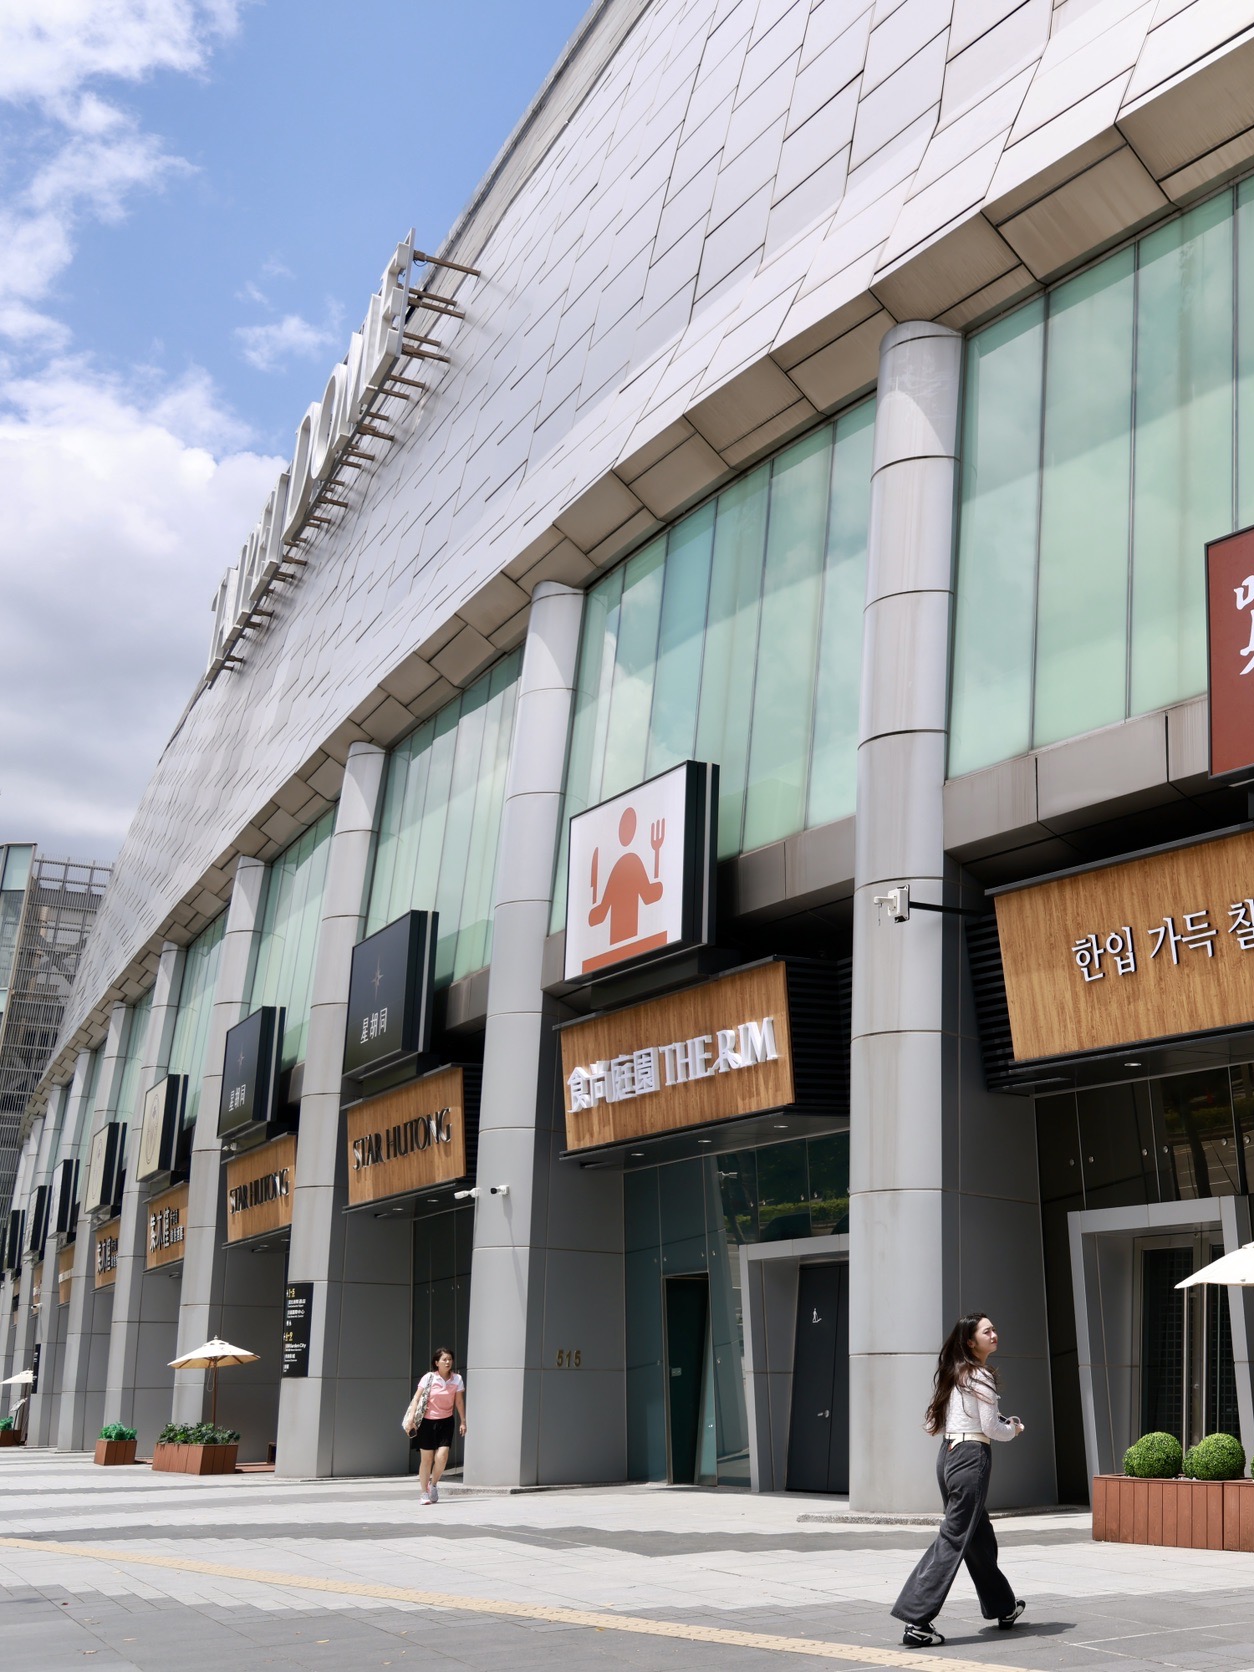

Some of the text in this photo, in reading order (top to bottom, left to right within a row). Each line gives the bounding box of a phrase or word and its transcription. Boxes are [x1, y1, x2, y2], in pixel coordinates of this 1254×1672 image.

[281, 228, 415, 541] DOME
[1072, 926, 1137, 982] 한입
[1147, 909, 1219, 965] 가득
[360, 1007, 388, 1044] 星胡同
[567, 1017, 779, 1113] 食尚庭園 THE RIM
[352, 1107, 452, 1171] STAR HUTONG
[229, 1168, 290, 1214] STAR HUTONG
[556, 1349, 581, 1367] 515
